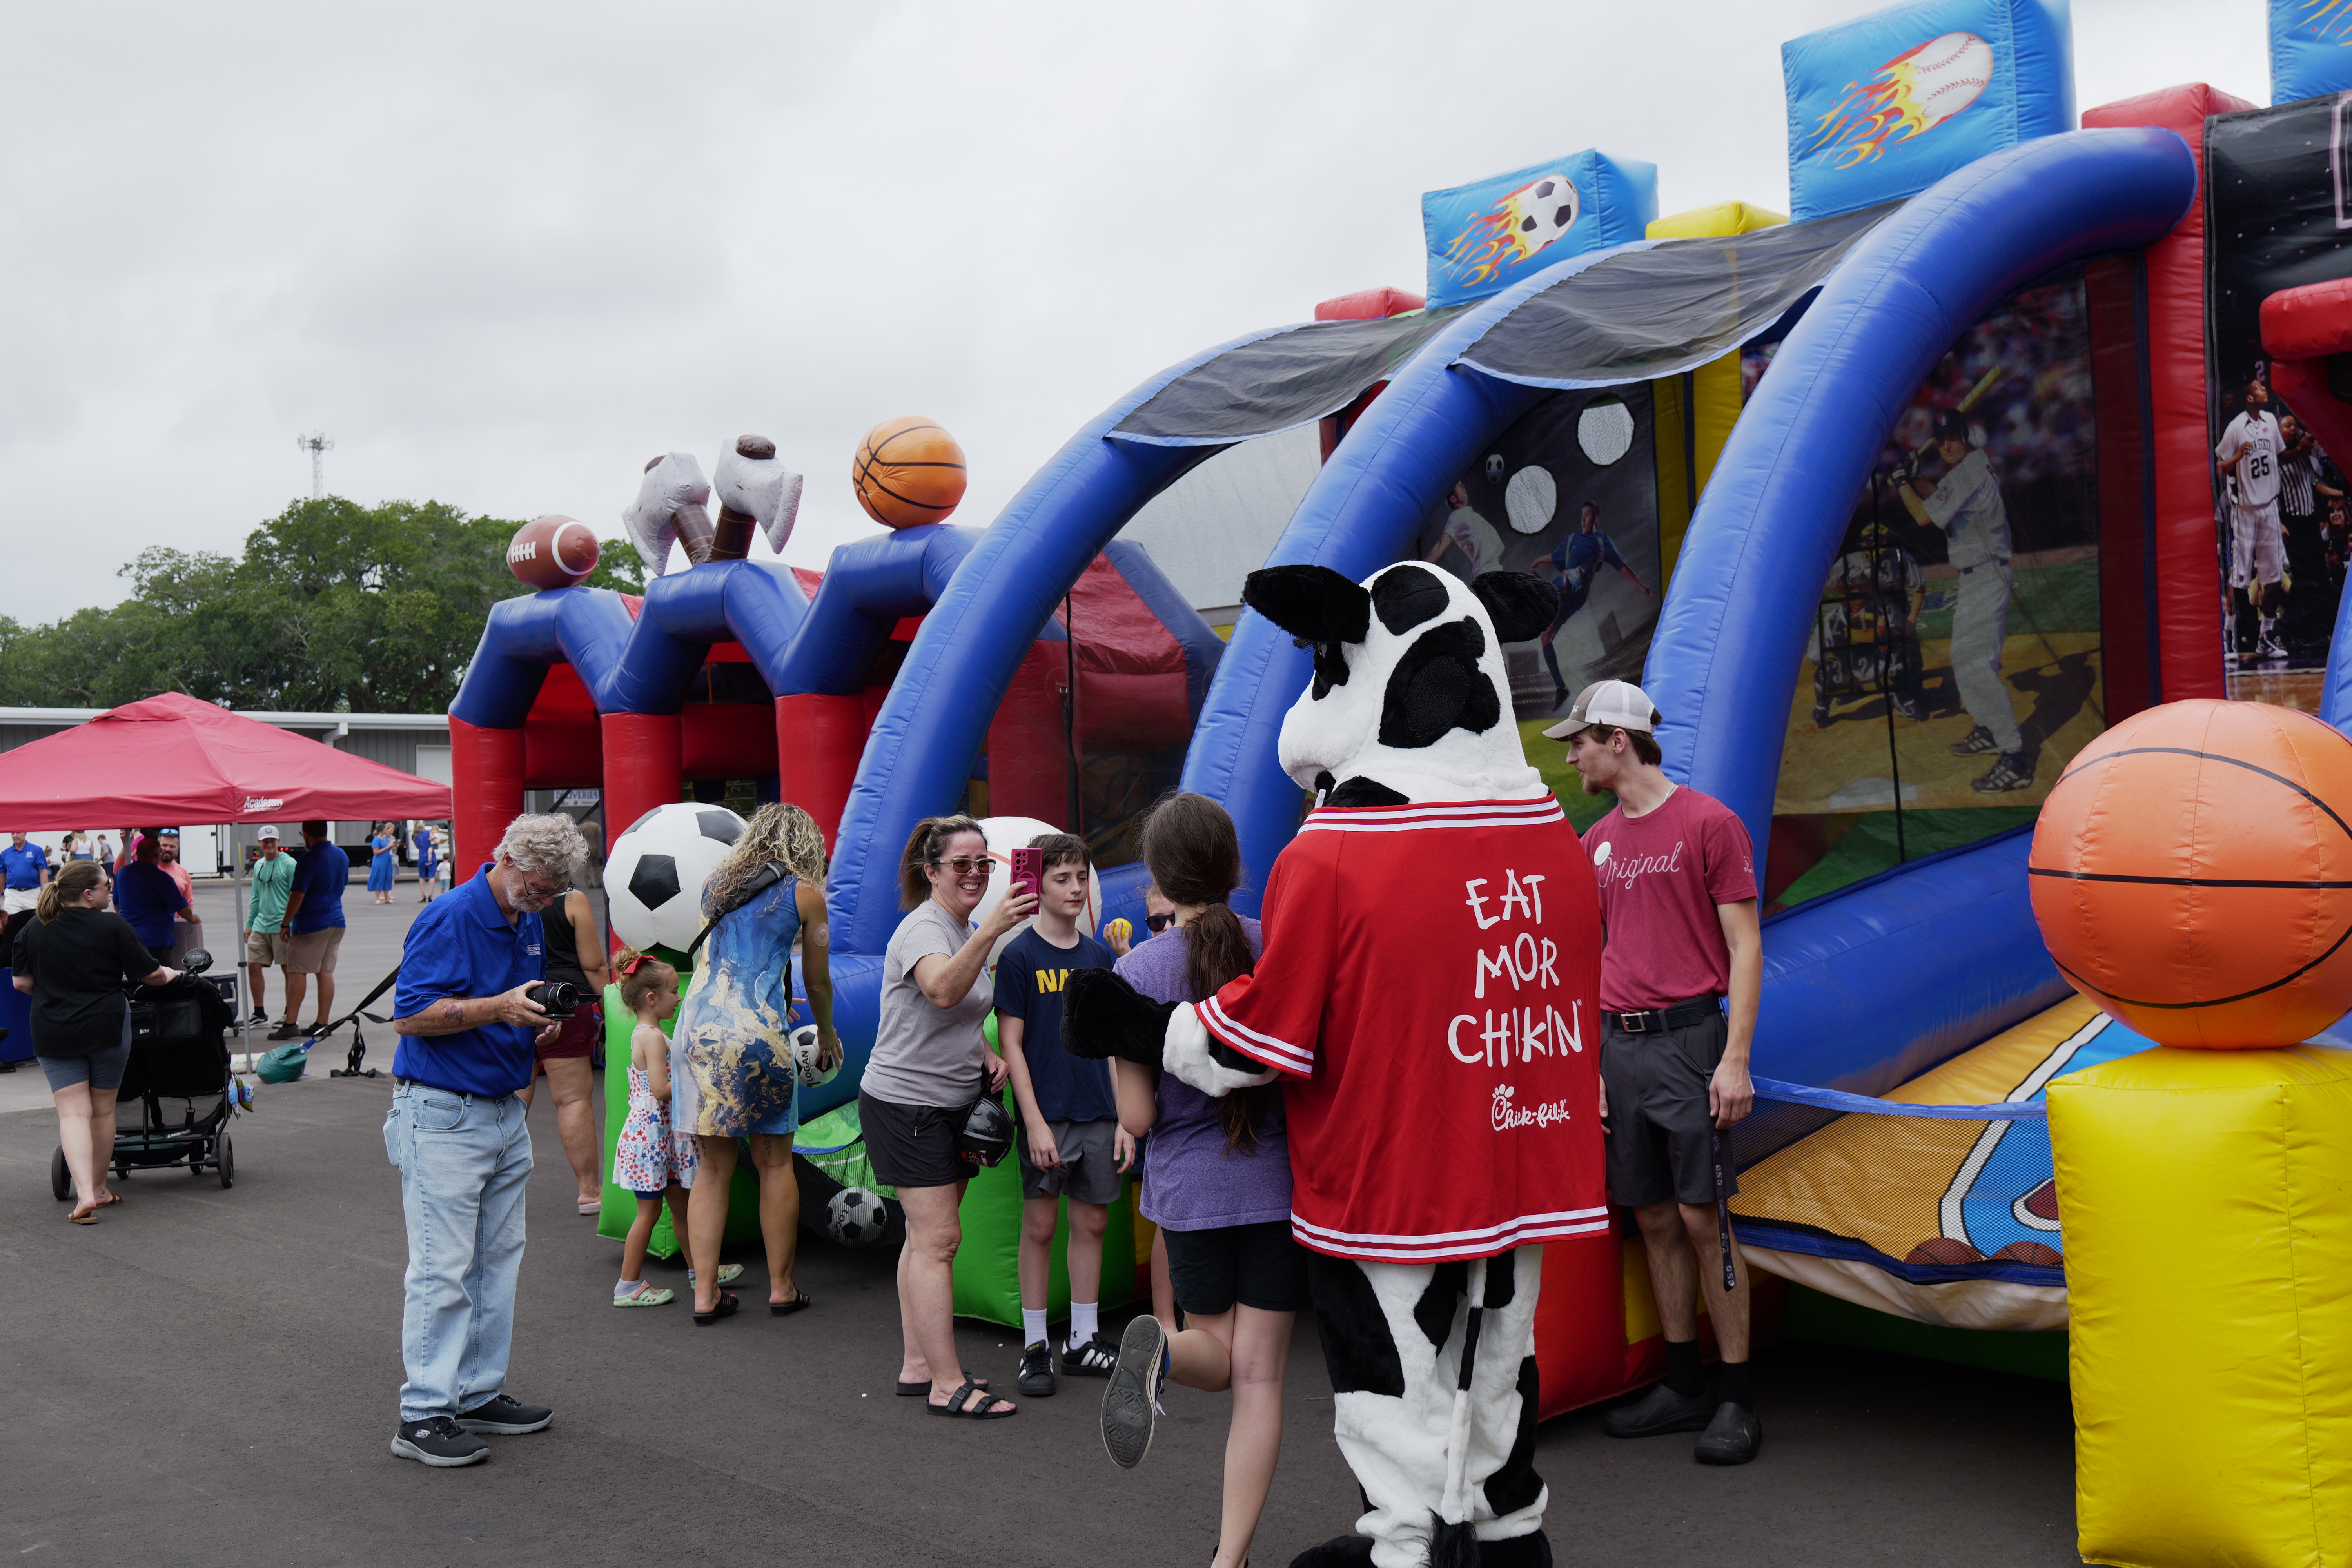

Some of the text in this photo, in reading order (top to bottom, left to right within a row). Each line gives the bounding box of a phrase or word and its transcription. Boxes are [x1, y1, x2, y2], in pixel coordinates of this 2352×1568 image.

[2250, 454, 2269, 479] 25
[244, 795, 284, 809] Academy
[1598, 841, 1683, 889] Original
[1466, 869, 1545, 930] EAT
[1036, 968, 1076, 994] NA
[1475, 933, 1560, 999] MOR
[801, 1050, 814, 1082] LOGAN
